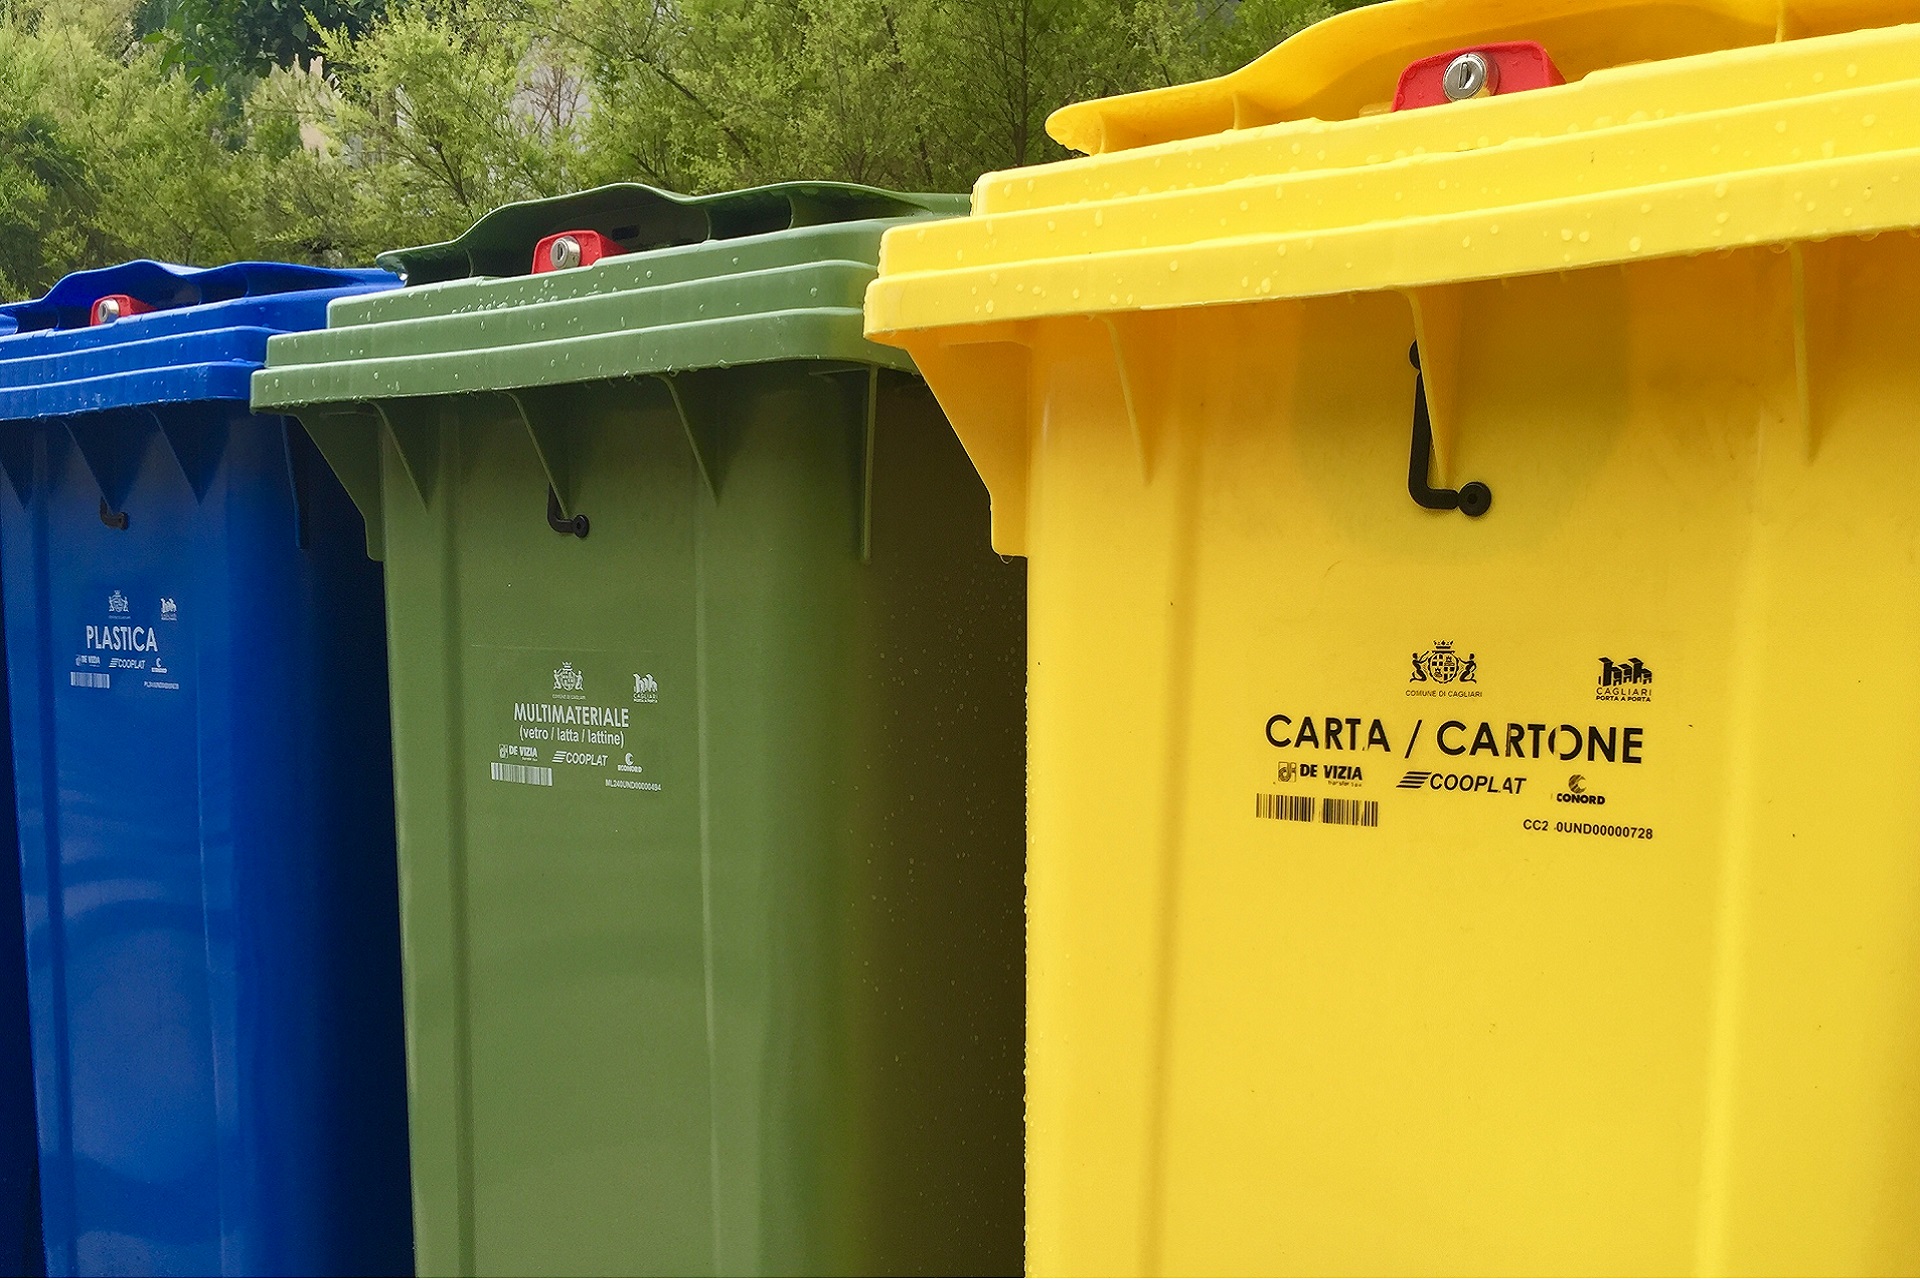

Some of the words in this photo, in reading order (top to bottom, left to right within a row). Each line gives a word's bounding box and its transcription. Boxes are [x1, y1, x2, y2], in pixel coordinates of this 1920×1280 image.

[86, 625, 158, 652] PLASTICA
[1596, 687, 1652, 696] CAGLIARI
[514, 702, 630, 728] MULTIMATERIALE
[519, 724, 549, 741] (vetro
[557, 727, 580, 743] latta
[588, 728, 625, 749] lattine)
[1265, 714, 1391, 752] CARTA
[1404, 719, 1422, 758] /
[1436, 720, 1643, 764] CARTONE
[509, 744, 518, 756] DE
[519, 746, 538, 758] VIZIA
[566, 753, 609, 767] COOPLAT
[1300, 763, 1318, 777] DE
[1323, 765, 1363, 780] VIZIA
[1430, 773, 1527, 794] COOPLAT
[1551, 792, 1606, 805] CONORD
